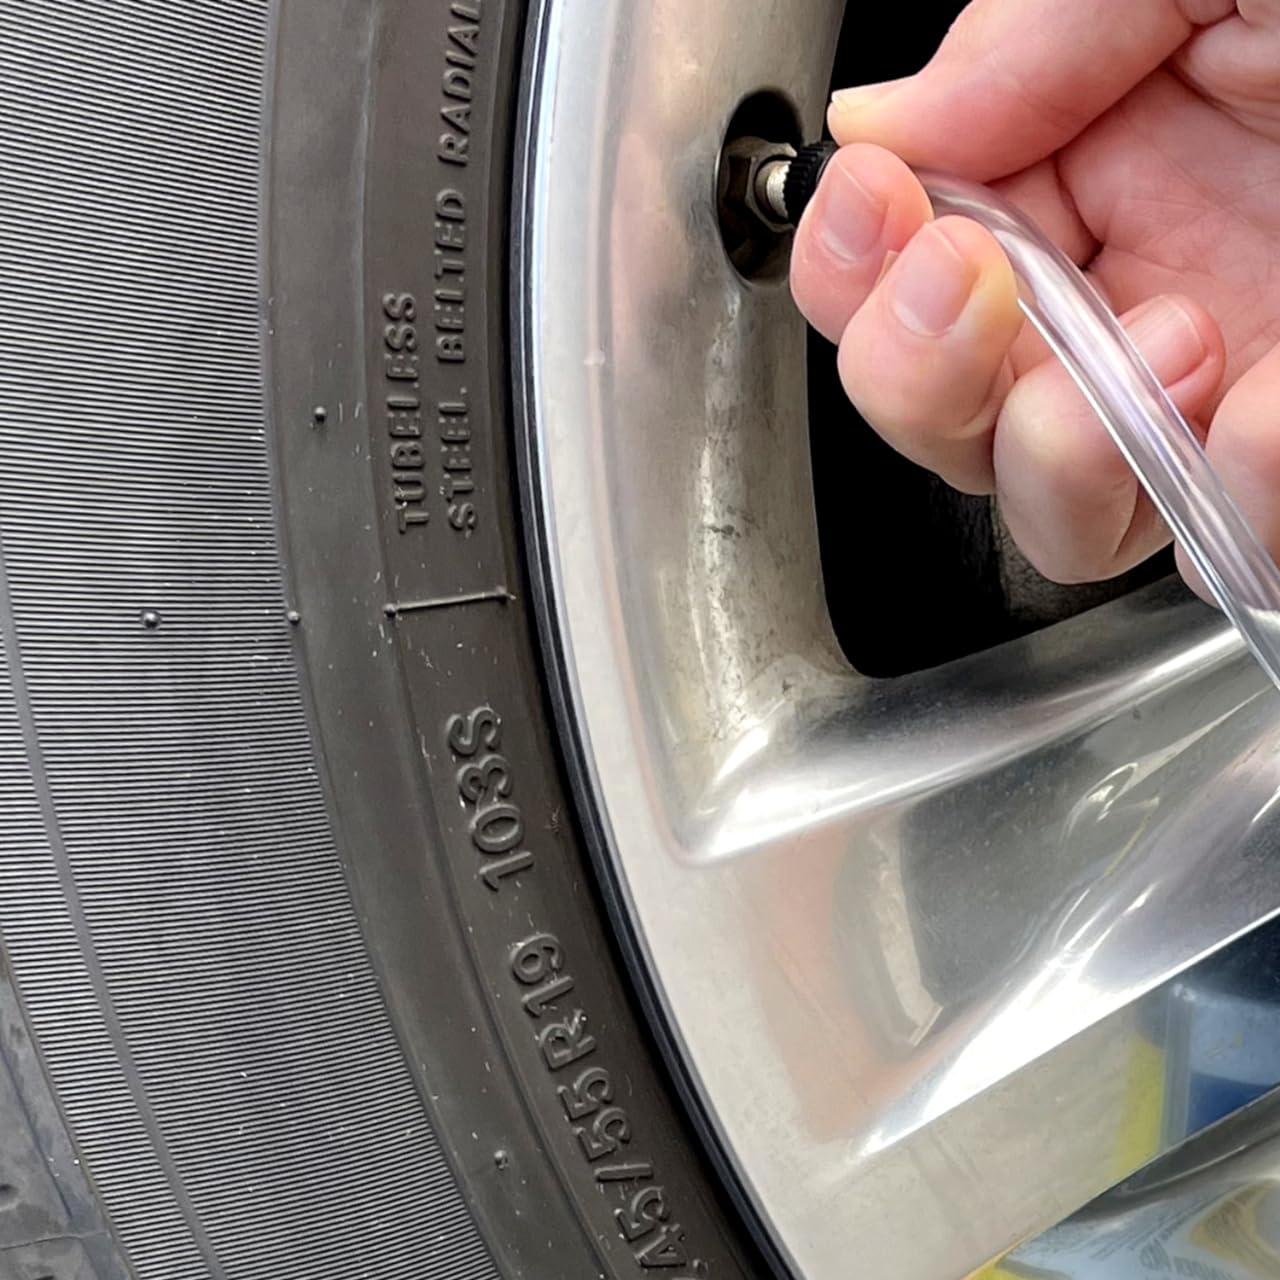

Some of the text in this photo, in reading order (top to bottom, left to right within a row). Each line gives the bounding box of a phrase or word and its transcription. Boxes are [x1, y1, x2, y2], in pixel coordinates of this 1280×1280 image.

[434, 0, 483, 537] STEEL BELTED RADIAL
[383, 292, 430, 534] TUBELESS
[445, 704, 535, 892] 103S
